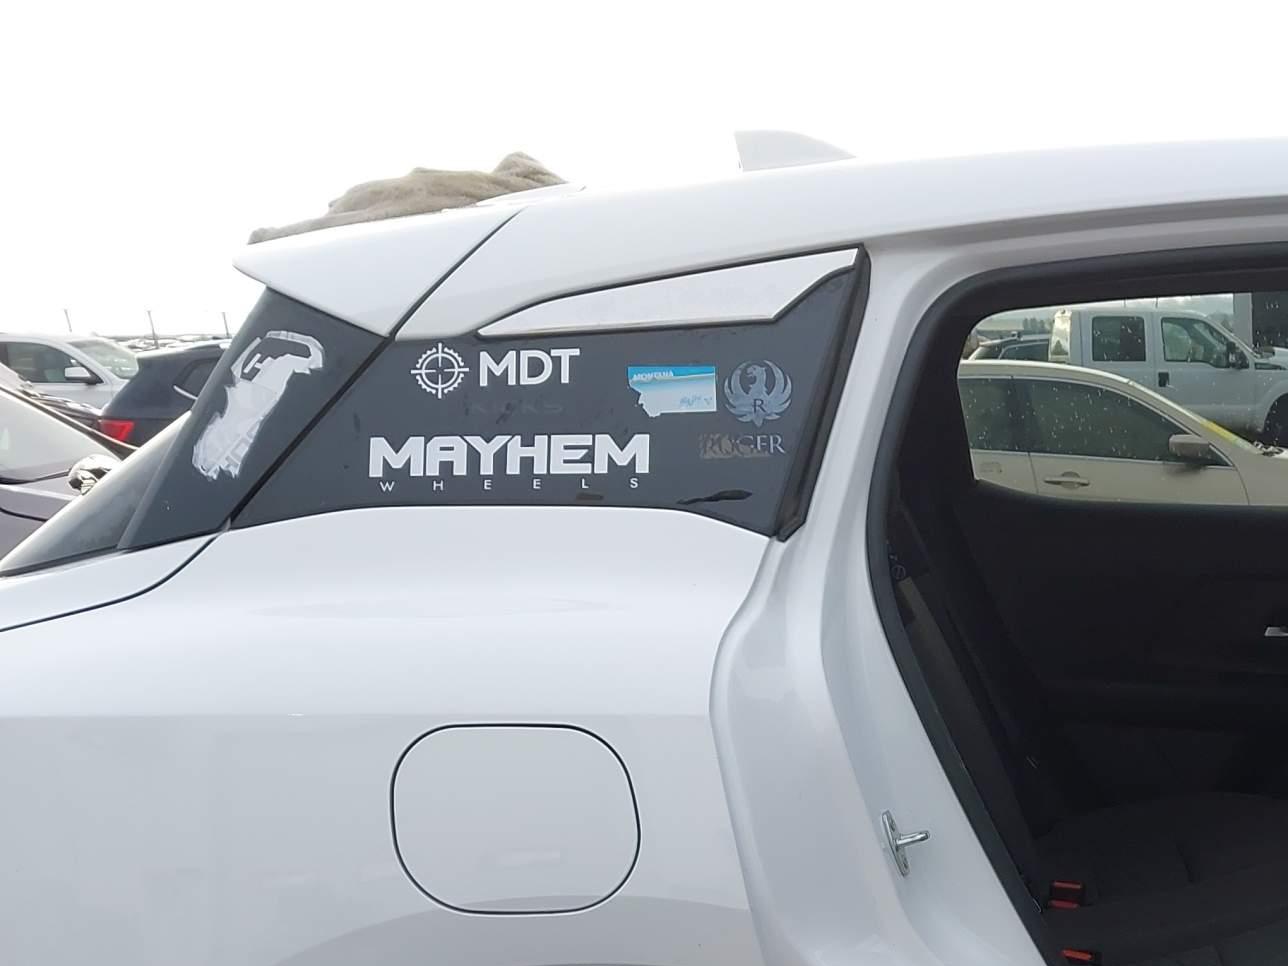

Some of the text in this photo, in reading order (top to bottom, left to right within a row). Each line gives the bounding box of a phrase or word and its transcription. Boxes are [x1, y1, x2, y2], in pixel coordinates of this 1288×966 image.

[479, 348, 581, 387] MDT
[368, 433, 651, 478] MAYHEM
[379, 477, 639, 492] WHEELS
